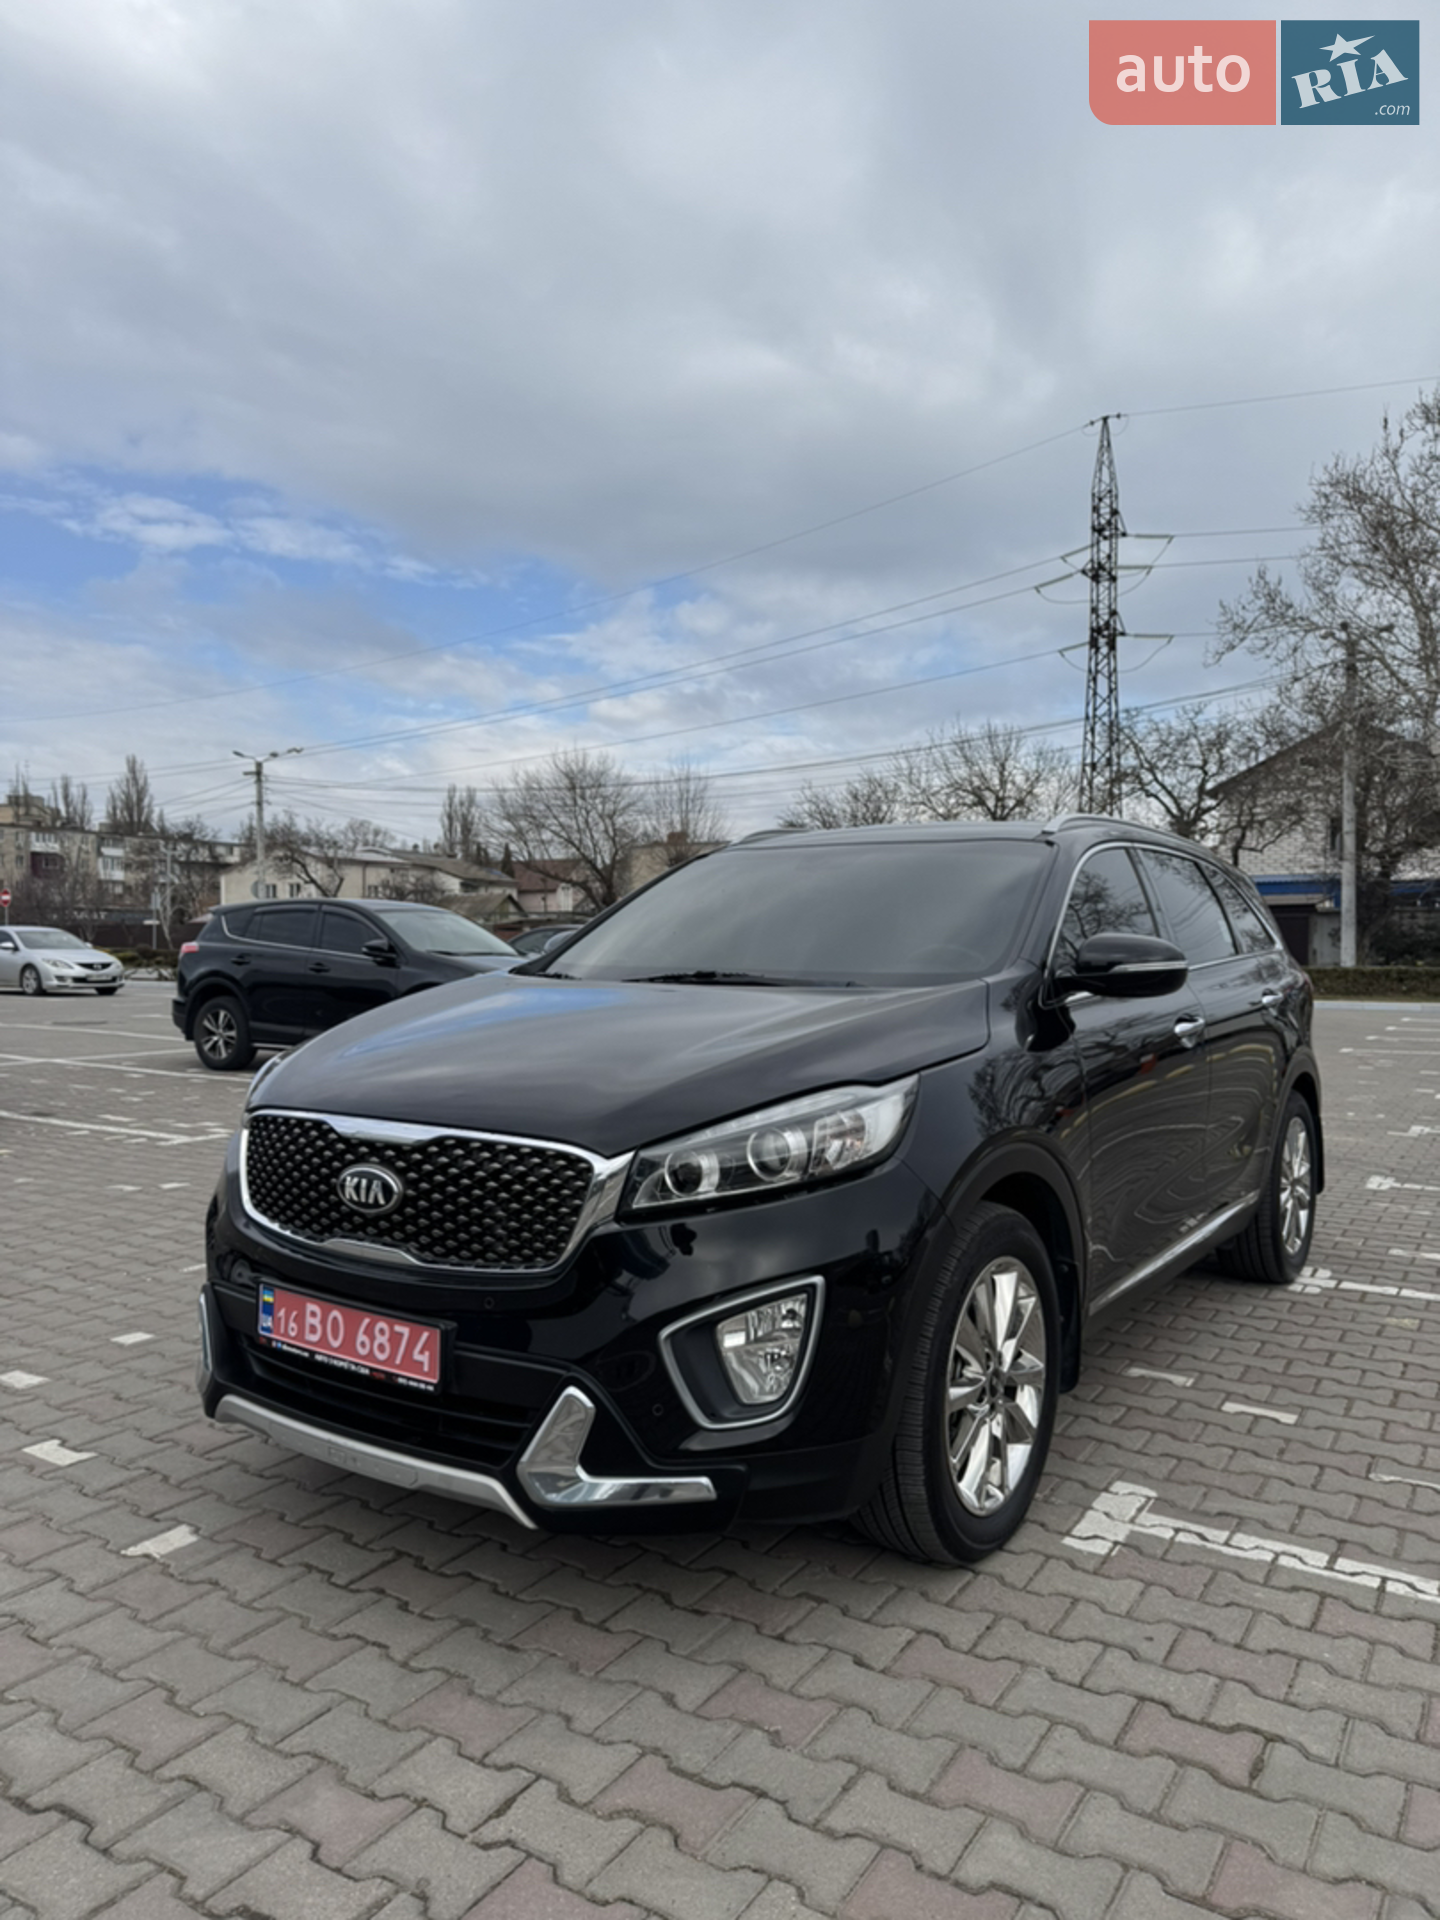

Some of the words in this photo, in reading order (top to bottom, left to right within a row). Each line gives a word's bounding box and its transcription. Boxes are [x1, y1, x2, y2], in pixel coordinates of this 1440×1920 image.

[344, 1175, 386, 1206] KIA
[276, 1307, 298, 1338] 16
[304, 1302, 345, 1349] BO
[355, 1317, 430, 1373] 6874
